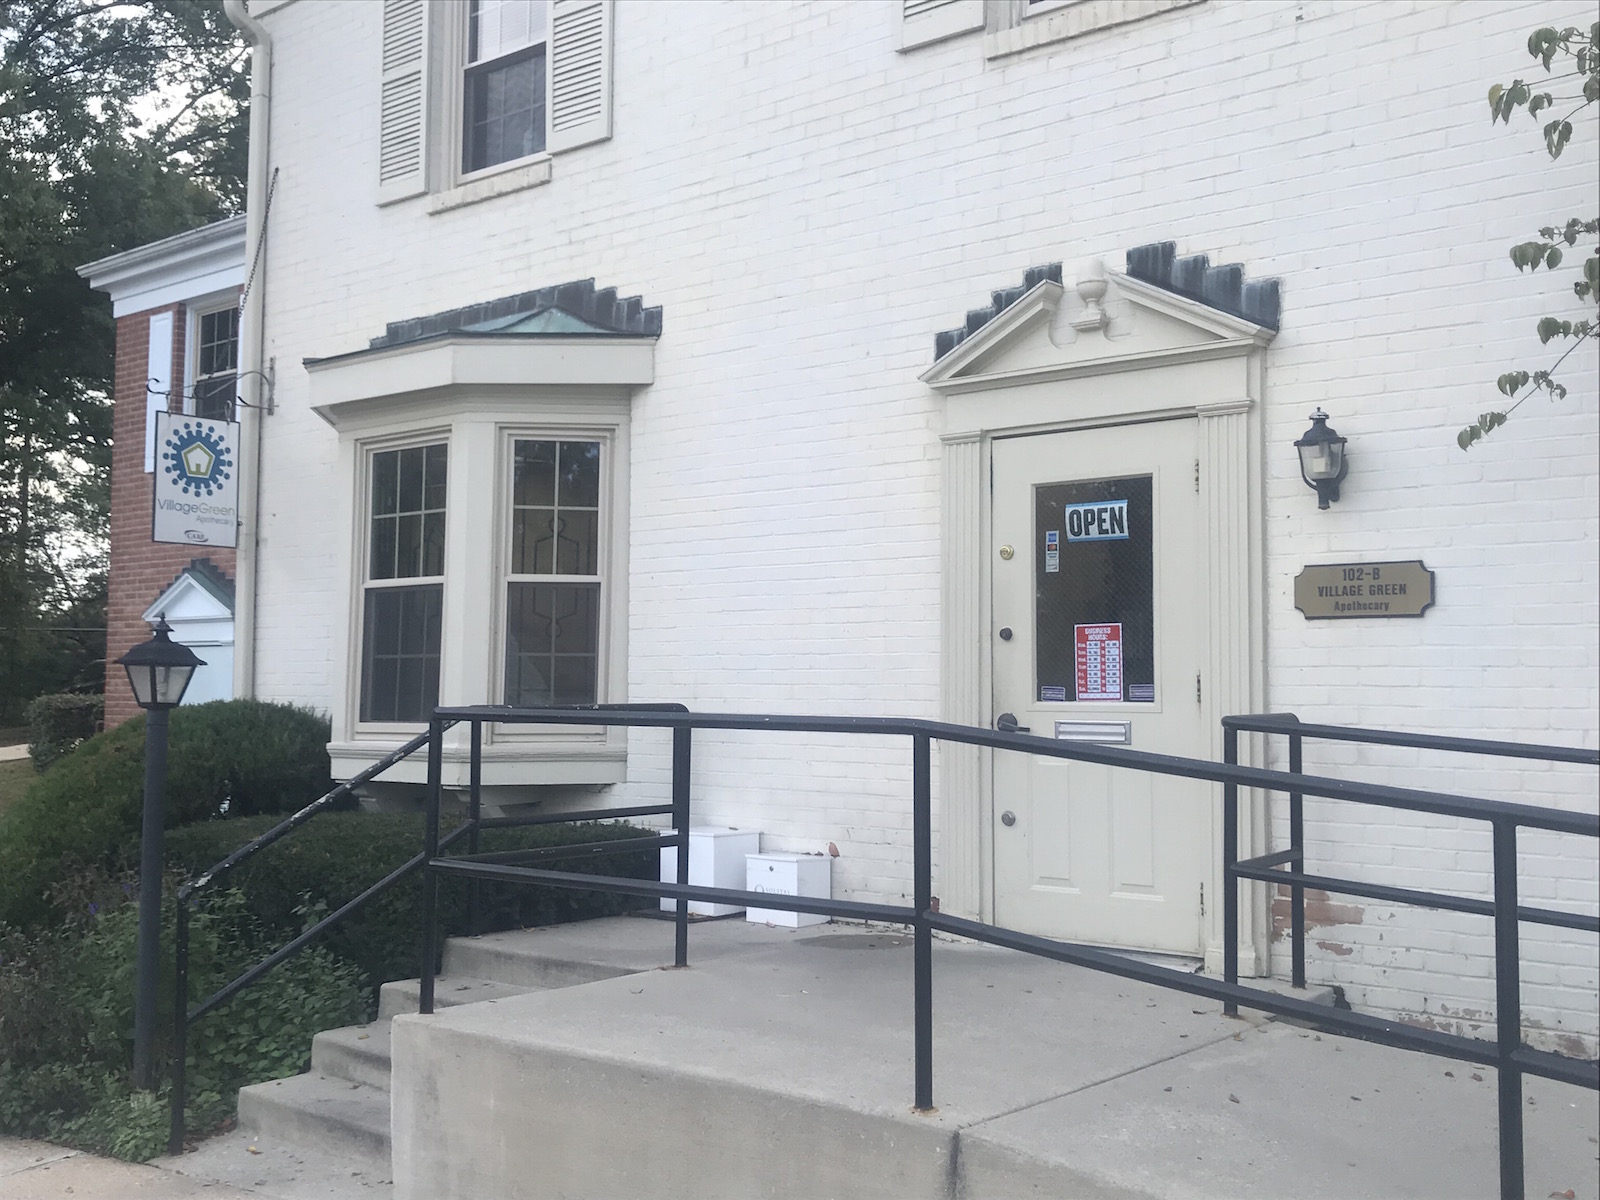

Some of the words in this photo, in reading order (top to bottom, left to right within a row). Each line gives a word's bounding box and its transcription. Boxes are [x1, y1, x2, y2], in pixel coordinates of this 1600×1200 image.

[1068, 506, 1125, 537] OPEN
[1342, 567, 1381, 581] 102-B
[1317, 584, 1364, 597] VILLAGE
[1369, 583, 1408, 596] GREEN
[1334, 600, 1390, 613] Apothecary
